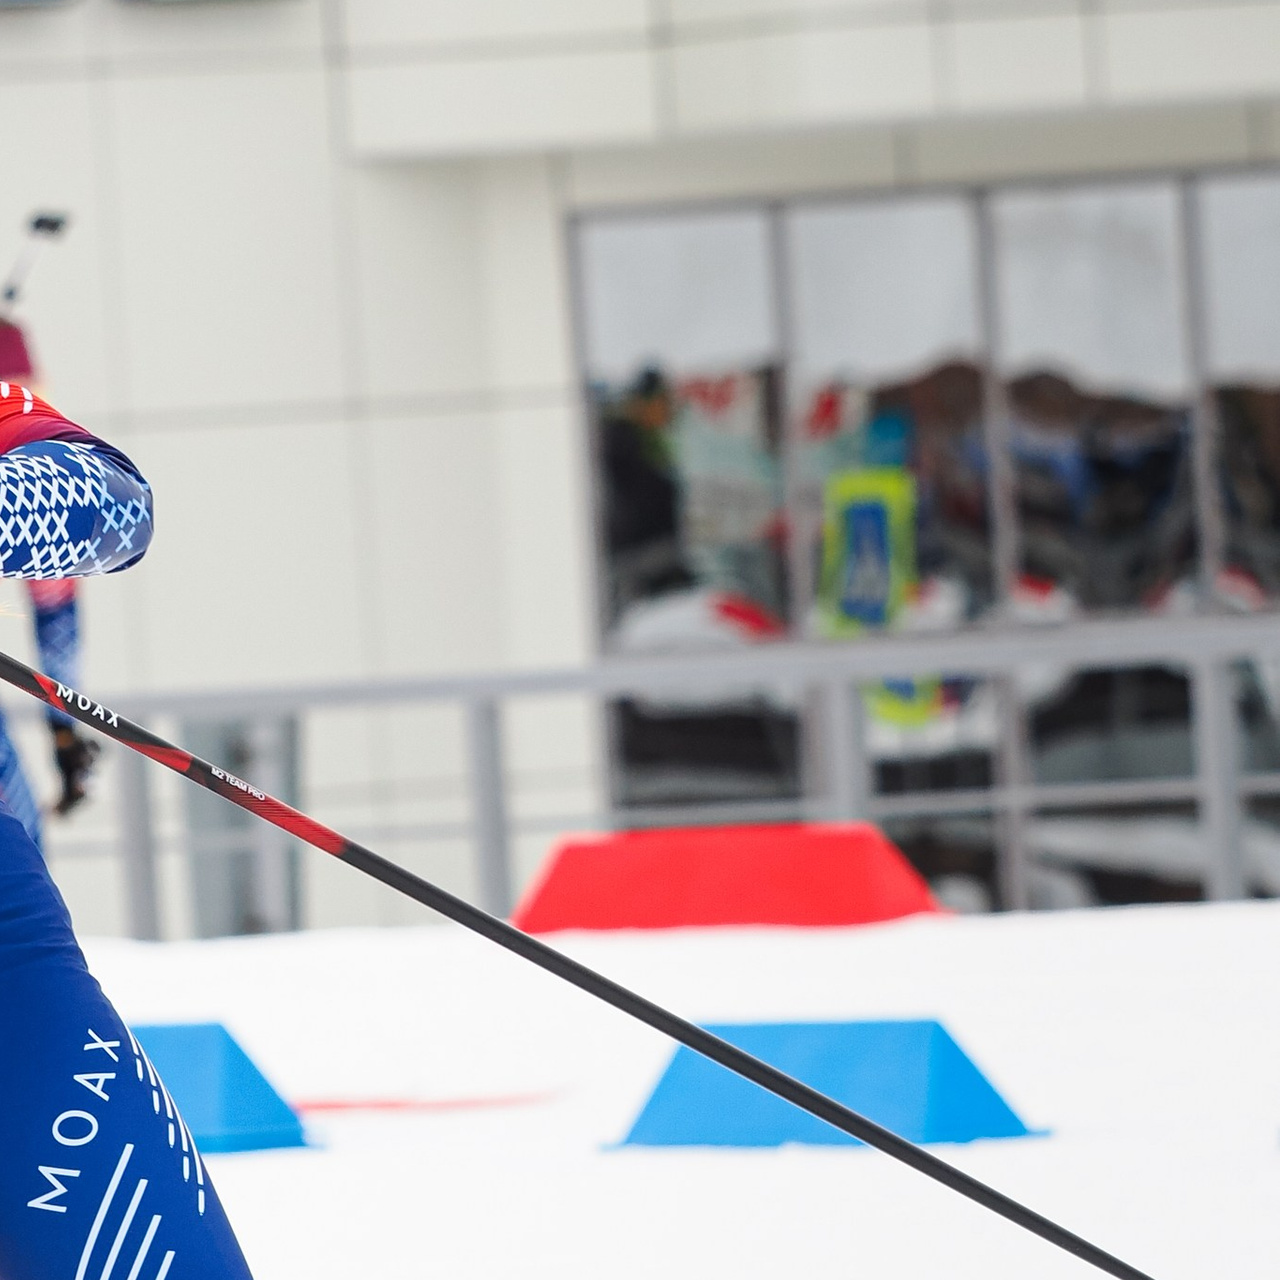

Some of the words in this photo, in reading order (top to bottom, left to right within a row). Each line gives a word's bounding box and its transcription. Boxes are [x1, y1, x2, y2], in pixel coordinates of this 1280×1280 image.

[56, 682, 120, 728] MOAX
[225, 774, 248, 792] TEAM
[248, 786, 266, 801] PRO
[27, 1028, 120, 1213] MOAX
